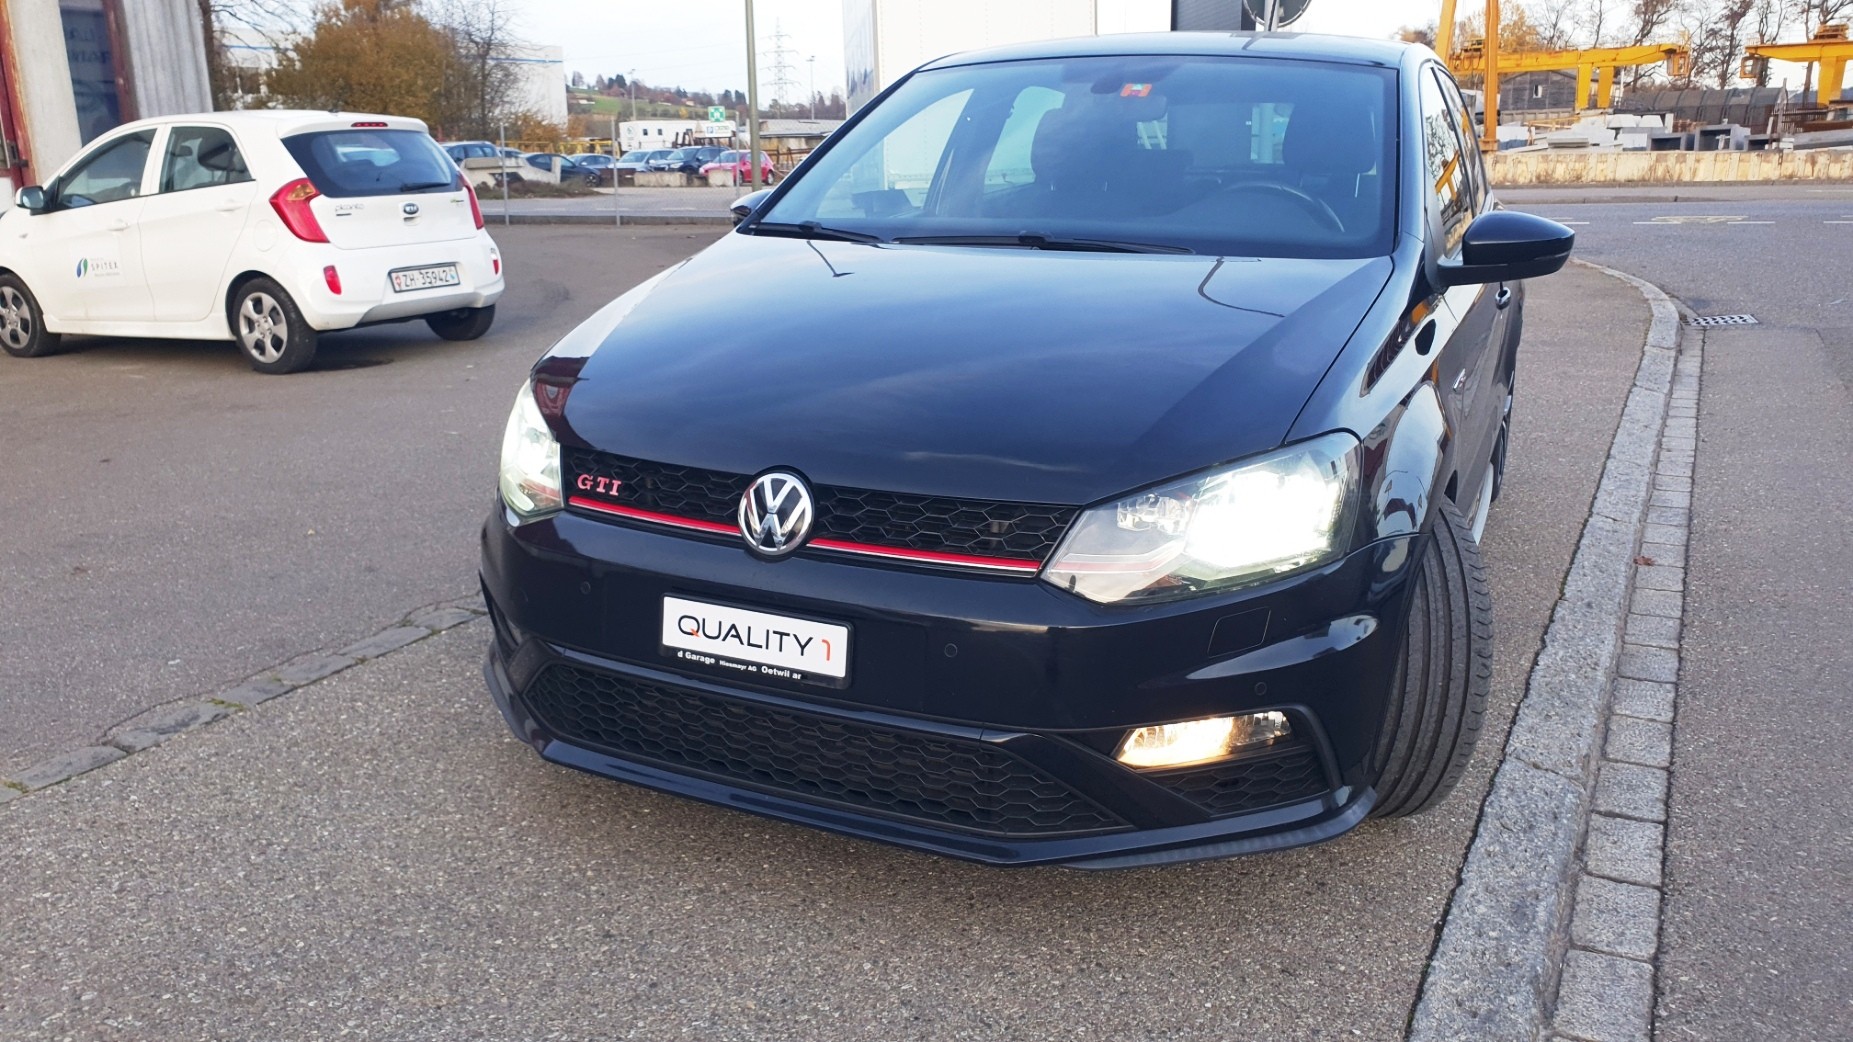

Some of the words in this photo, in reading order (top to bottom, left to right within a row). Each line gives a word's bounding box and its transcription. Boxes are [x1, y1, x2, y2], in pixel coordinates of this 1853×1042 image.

[577, 473, 622, 496] GTI
[677, 614, 813, 656] QUALITY
[685, 651, 716, 664] Garage
[761, 665, 790, 678] Oetwil
